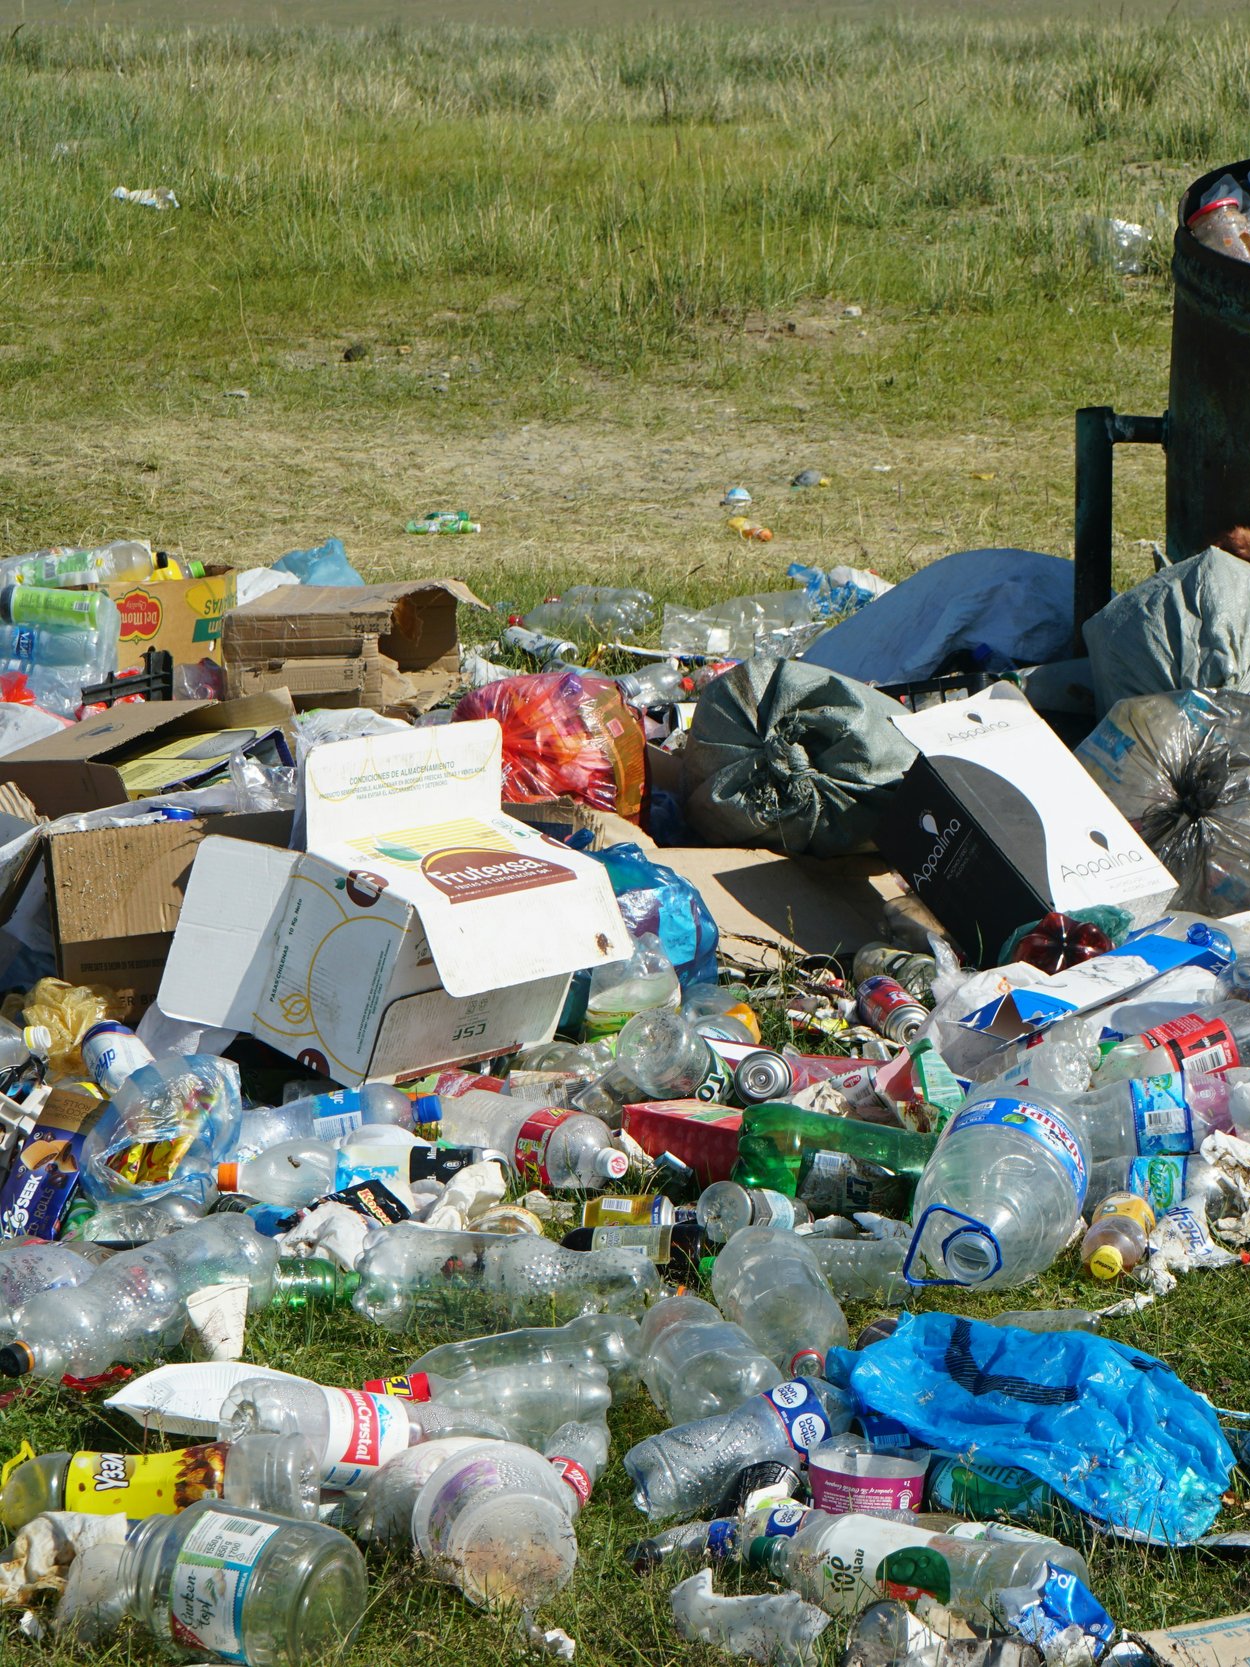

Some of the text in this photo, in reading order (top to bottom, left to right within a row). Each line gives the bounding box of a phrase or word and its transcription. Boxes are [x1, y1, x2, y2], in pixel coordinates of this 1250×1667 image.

[126, 600, 147, 610] Quality
[120, 612, 157, 625] Del Mon
[947, 720, 1009, 742] Appalina
[391, 769, 400, 780] DE
[401, 761, 455, 778] ALMACENAMIENTO
[913, 816, 961, 891] Appalina
[1060, 850, 1143, 883] Appalina
[427, 857, 541, 888] Frutexsa
[269, 945, 289, 1003] PASAS CHILENAS
[777, 1387, 794, 1405] aqua
[798, 1420, 811, 1446] aqua
[237, 1572, 249, 1598] EDEKA
